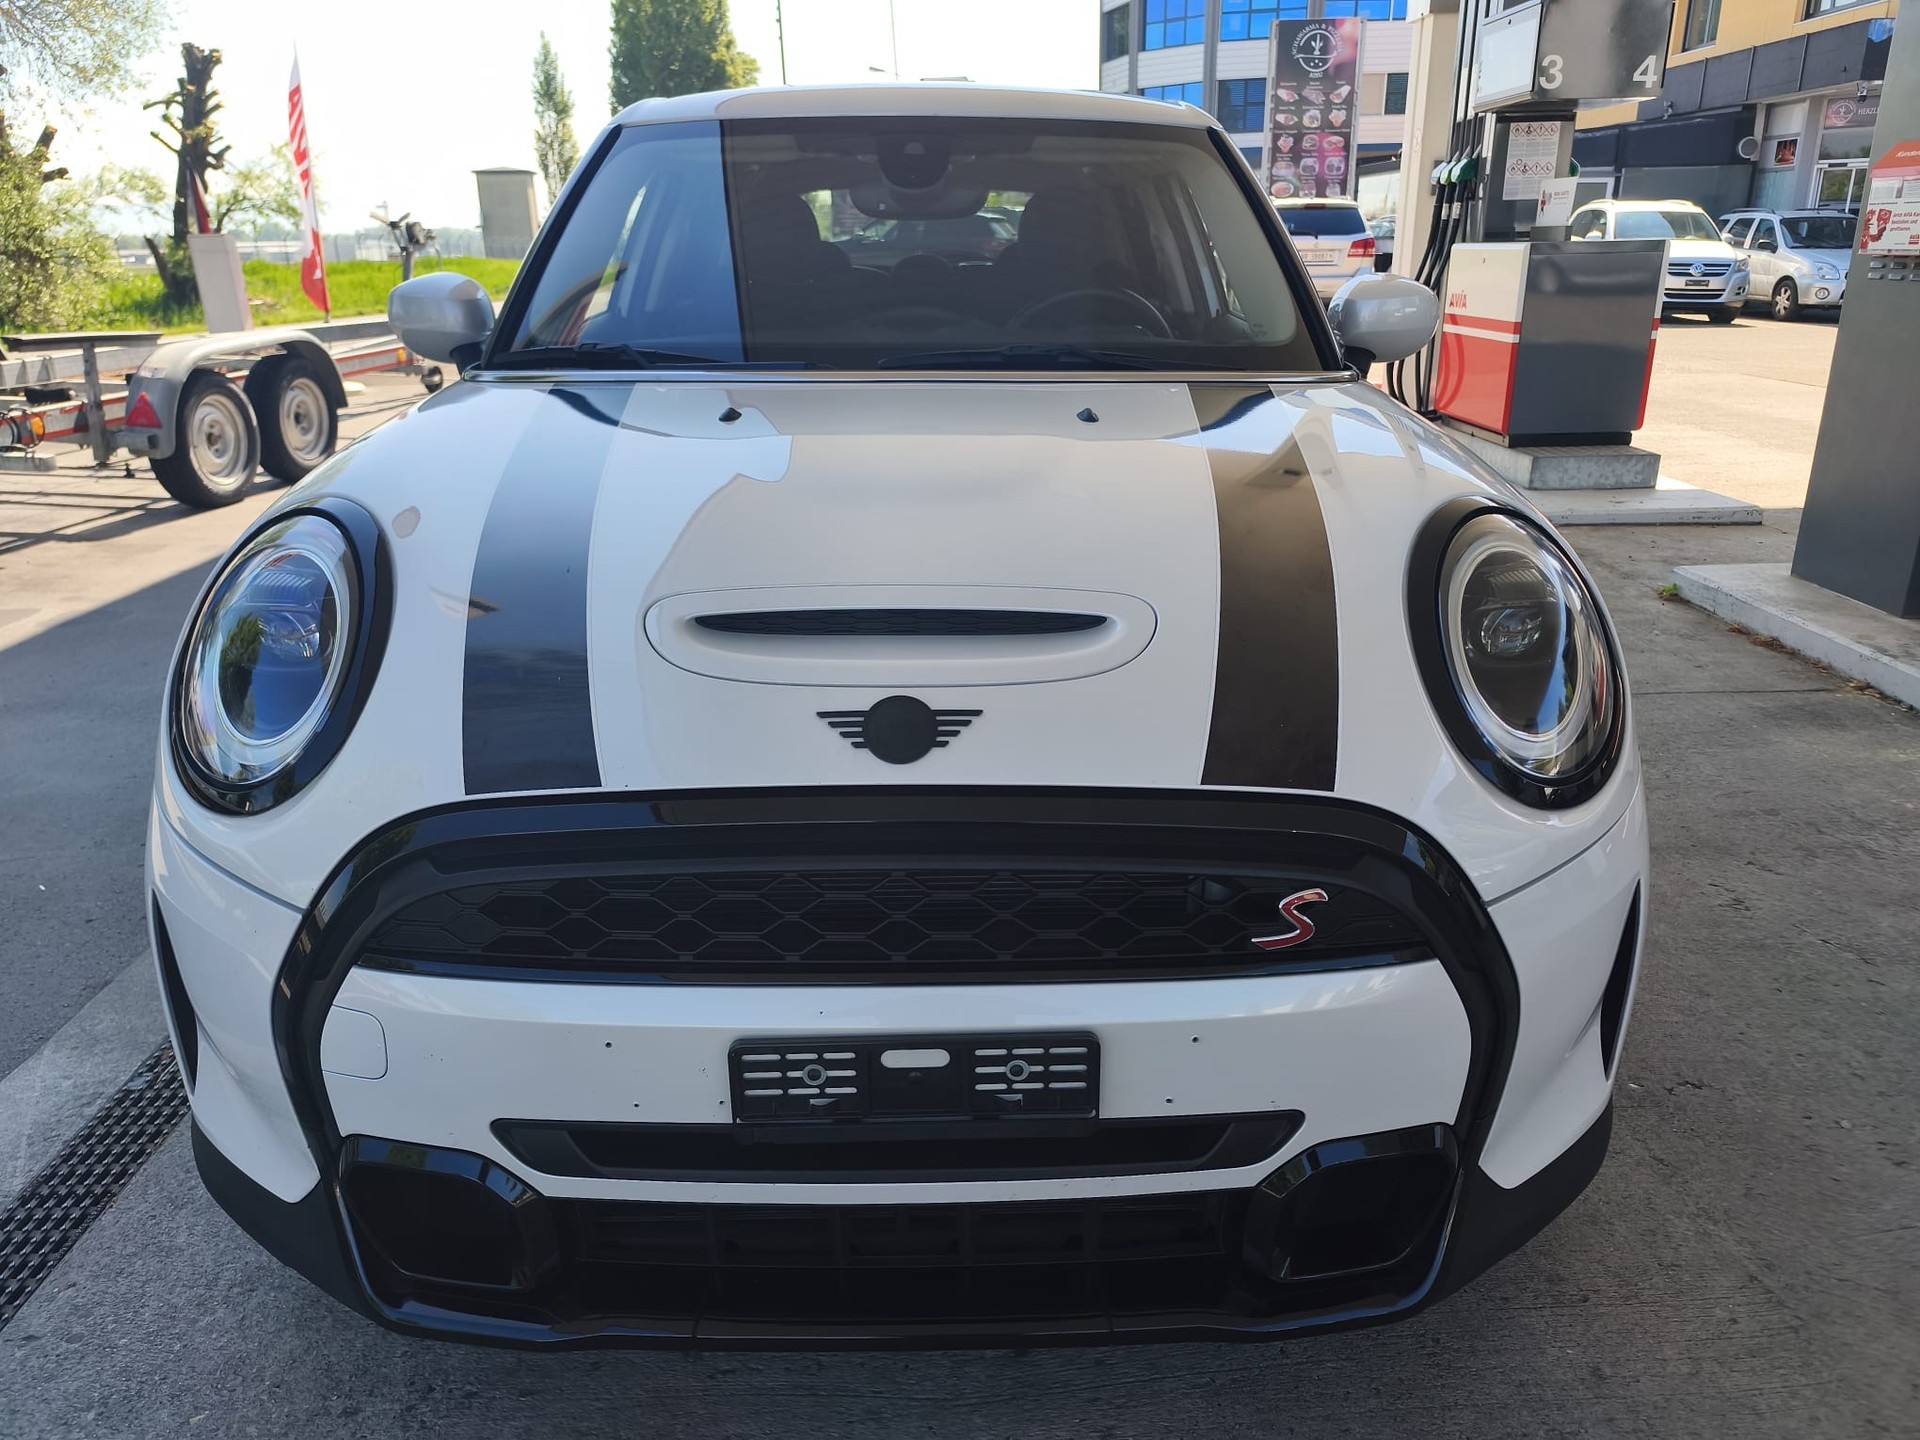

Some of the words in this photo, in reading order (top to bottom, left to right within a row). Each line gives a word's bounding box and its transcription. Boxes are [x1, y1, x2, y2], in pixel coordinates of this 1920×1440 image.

[1539, 54, 1564, 90] 3
[1632, 55, 1657, 88] 4
[1251, 888, 1328, 950] S
